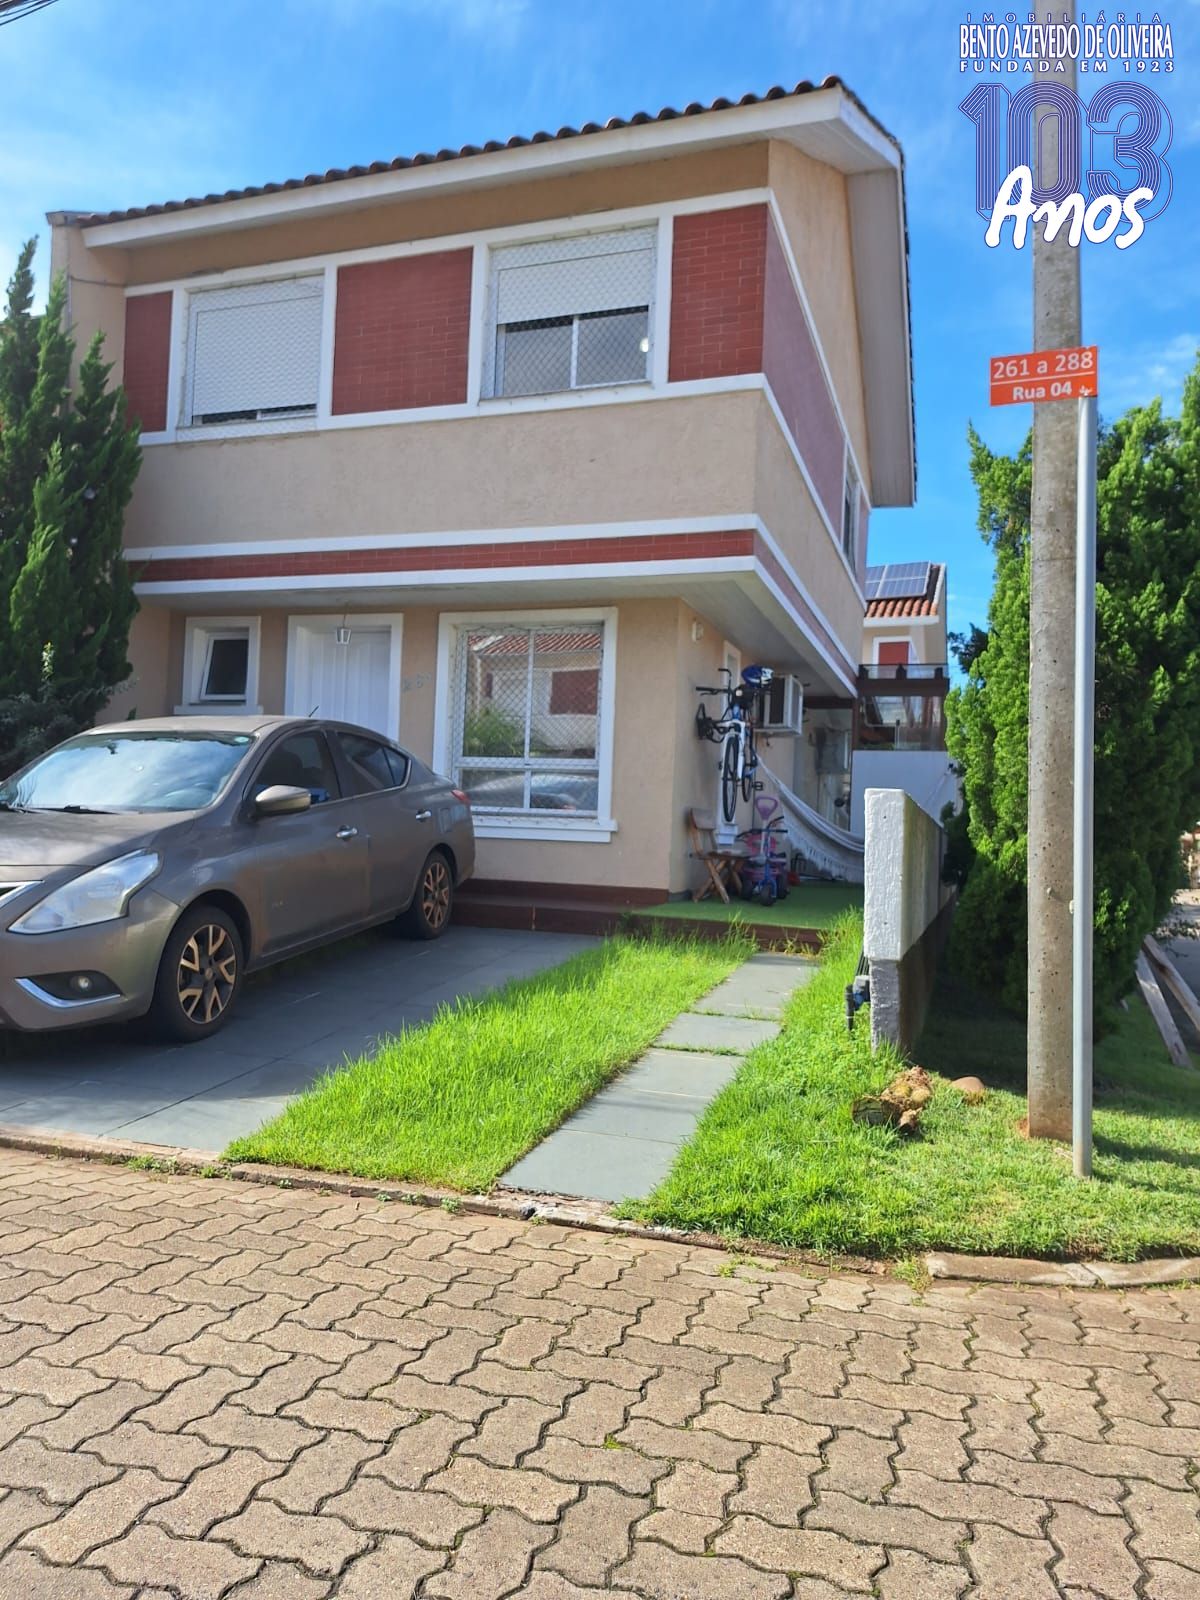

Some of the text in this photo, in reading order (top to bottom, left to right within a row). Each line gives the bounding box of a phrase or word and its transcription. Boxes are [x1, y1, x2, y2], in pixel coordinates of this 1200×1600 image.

[993, 351, 1093, 379] 261 a 288
[1012, 381, 1072, 401] Rua 04
